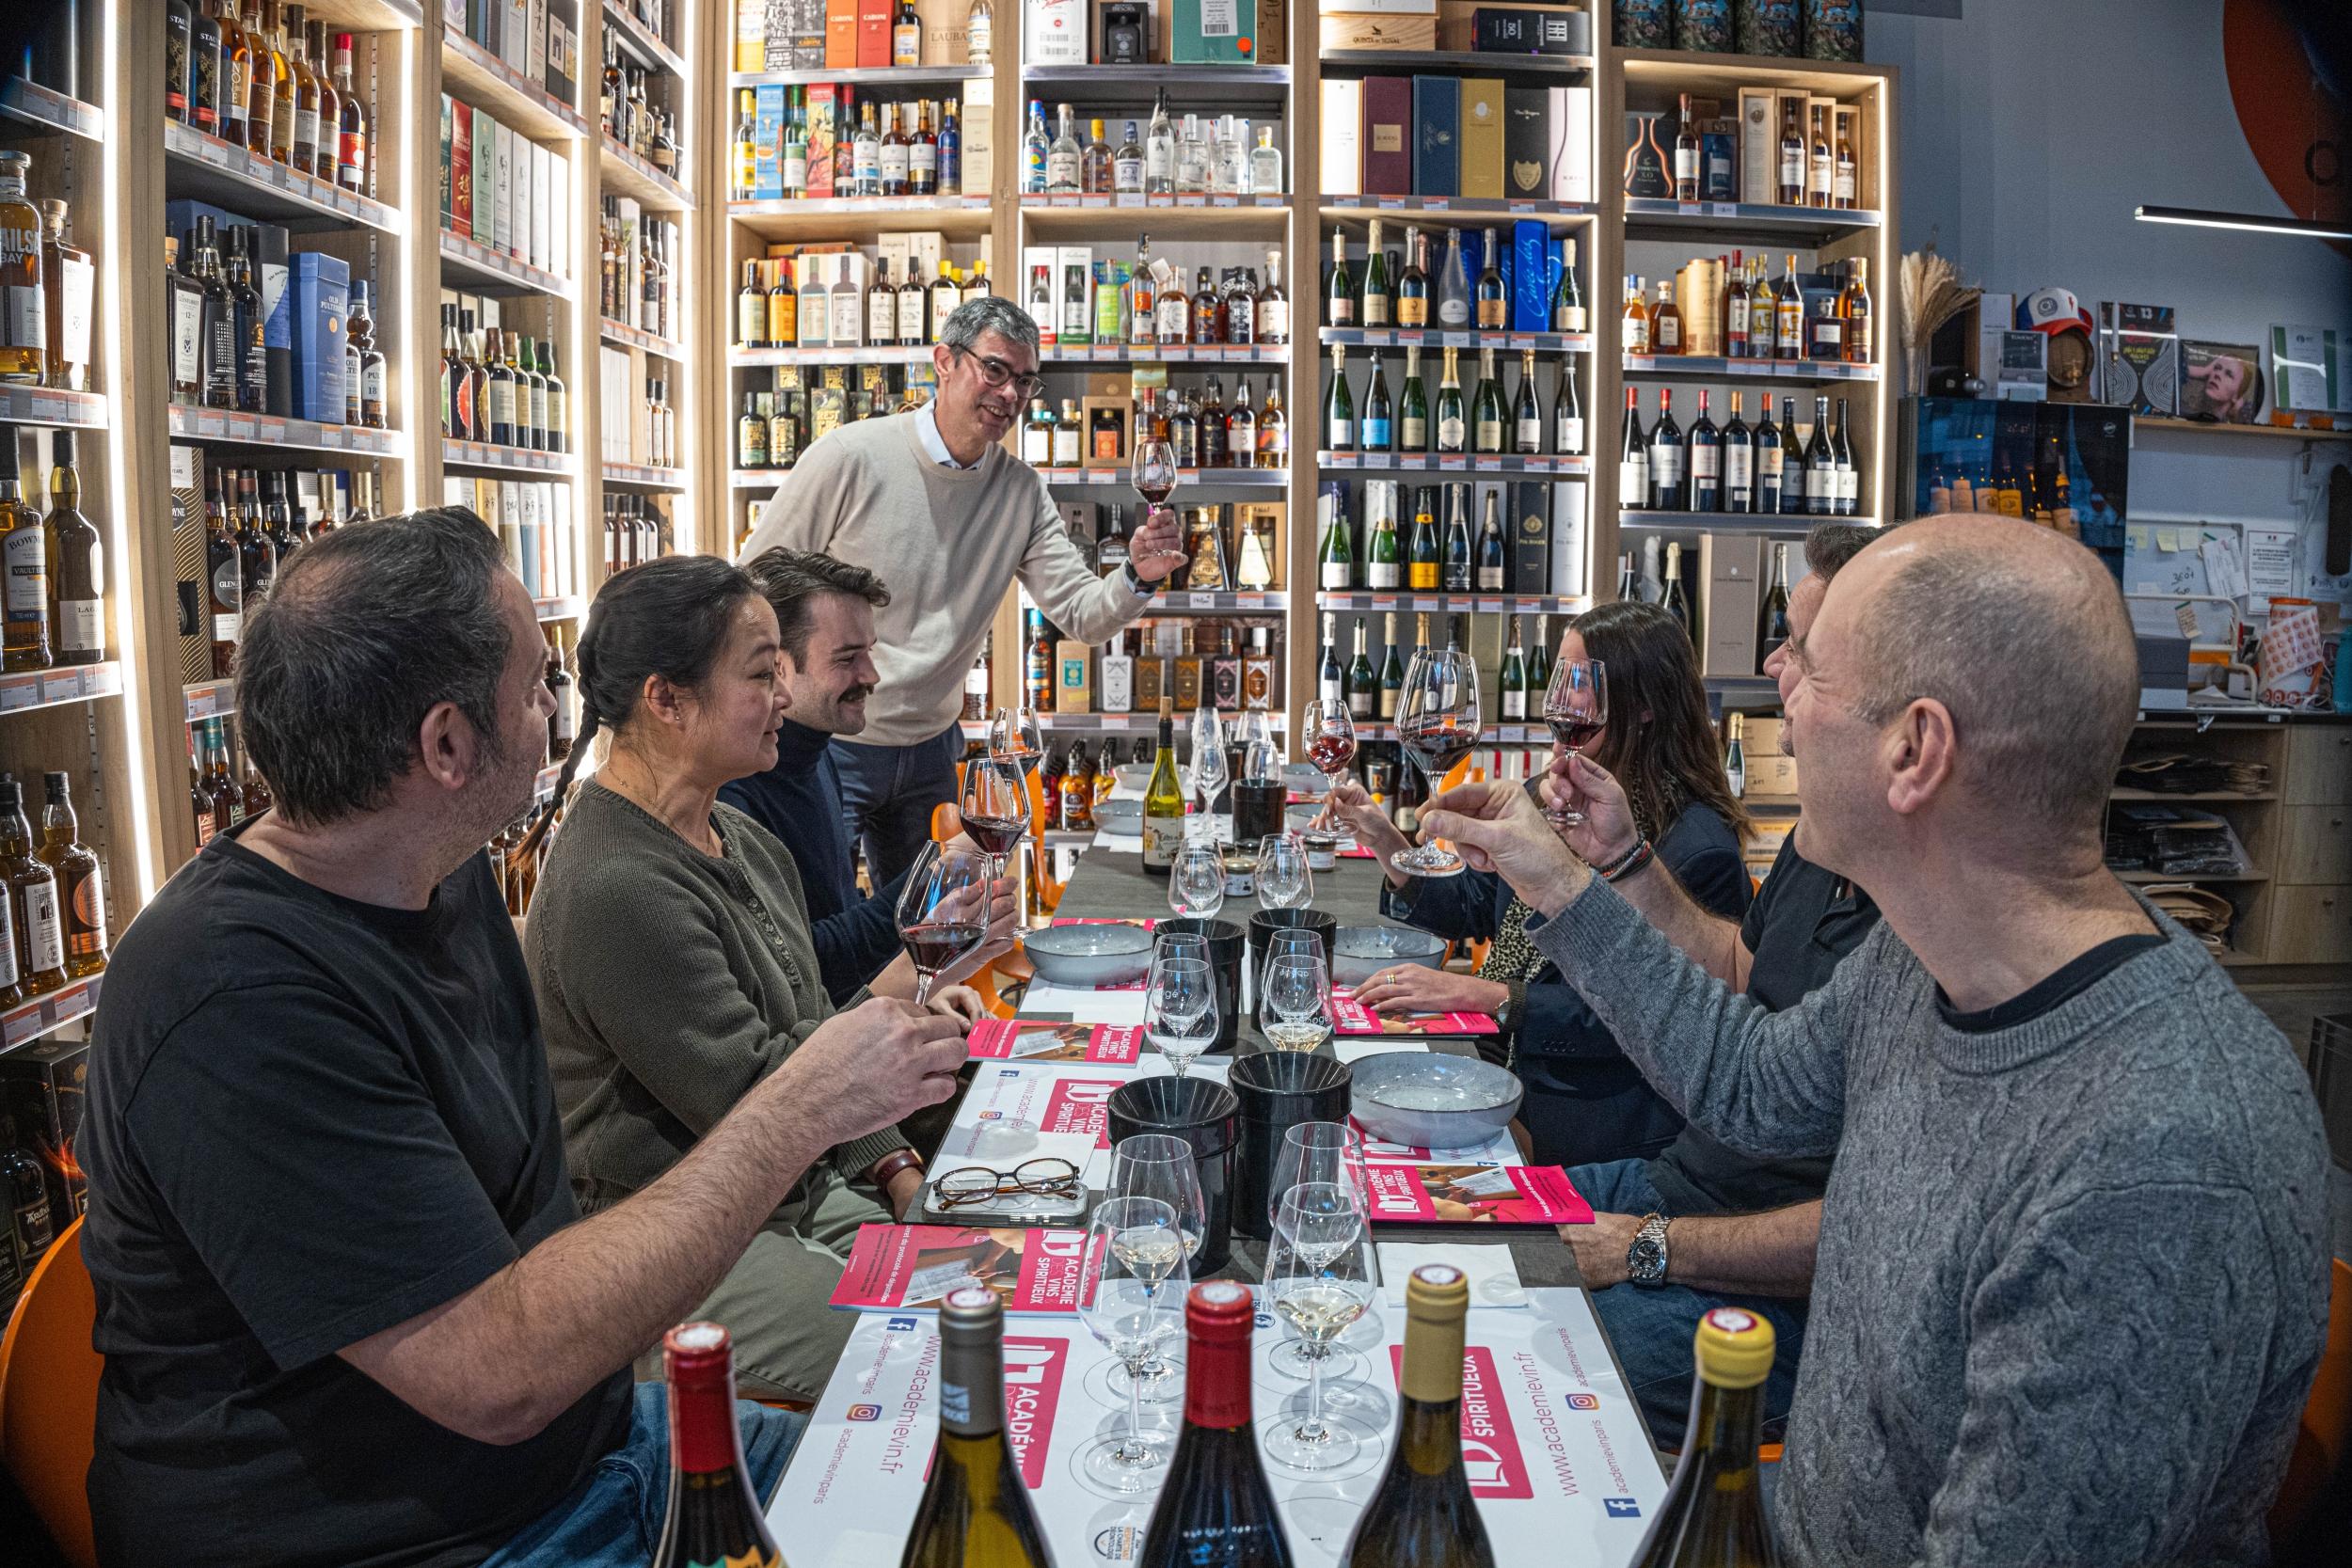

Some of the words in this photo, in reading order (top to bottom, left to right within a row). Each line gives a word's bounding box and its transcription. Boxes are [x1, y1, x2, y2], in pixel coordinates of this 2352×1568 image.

[930, 32, 967, 42] LAUBA
[1107, 1040, 1119, 1054] VINS
[1053, 1102, 1072, 1132] SPIRITUE
[894, 1245, 905, 1271] protocole
[1029, 1257, 1051, 1305] SPIRITUEUX
[1045, 1277, 1062, 1297] VINS
[863, 1333, 895, 1396] academievinparis
[1557, 1326, 1589, 1387] academievinparis
[880, 1334, 942, 1475] www.academievin.fr
[1009, 1386, 1040, 1473] ACADÉM
[1514, 1352, 1581, 1497] www.academievin.fr
[813, 1428, 854, 1505] academievinparis
[1591, 1419, 1629, 1495] academievinparis
